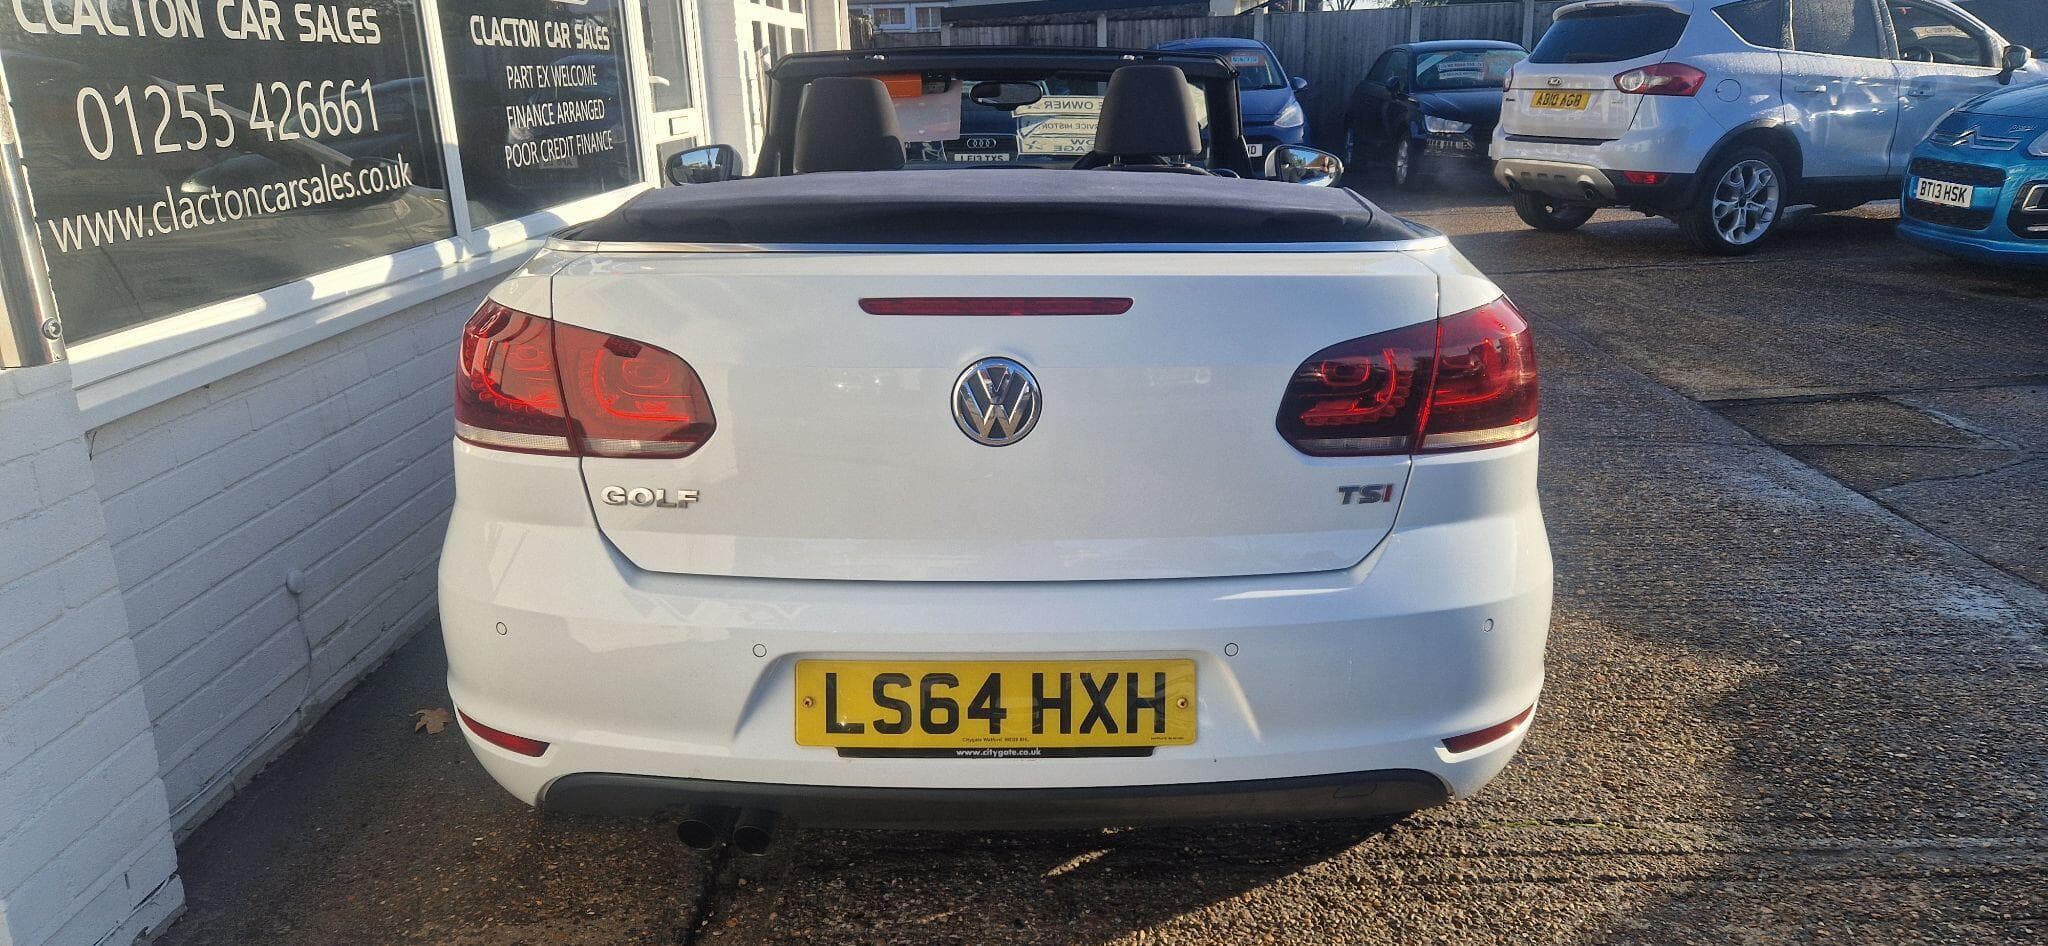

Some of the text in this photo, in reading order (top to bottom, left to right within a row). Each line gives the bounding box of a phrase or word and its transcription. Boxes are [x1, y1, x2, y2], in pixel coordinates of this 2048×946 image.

[12, 0, 381, 44] CLACTON CAR SALES
[470, 15, 610, 50] CLACTON CAR SALES
[506, 65, 597, 89] PART EX WELCOME
[76, 79, 379, 160] 01255 426661
[506, 99, 604, 129] FINANCE ARRANGED
[505, 130, 613, 169] POOR CREDIT FINANCE
[48, 153, 413, 253] www.clactoncarsales.co.uk
[1920, 181, 1967, 203] BT13 HSK
[600, 486, 699, 508] GOLF
[1338, 484, 1393, 504] TSI
[825, 672, 1165, 734] LS64 HXH
[956, 747, 1041, 758] www.citygate.co.uk
